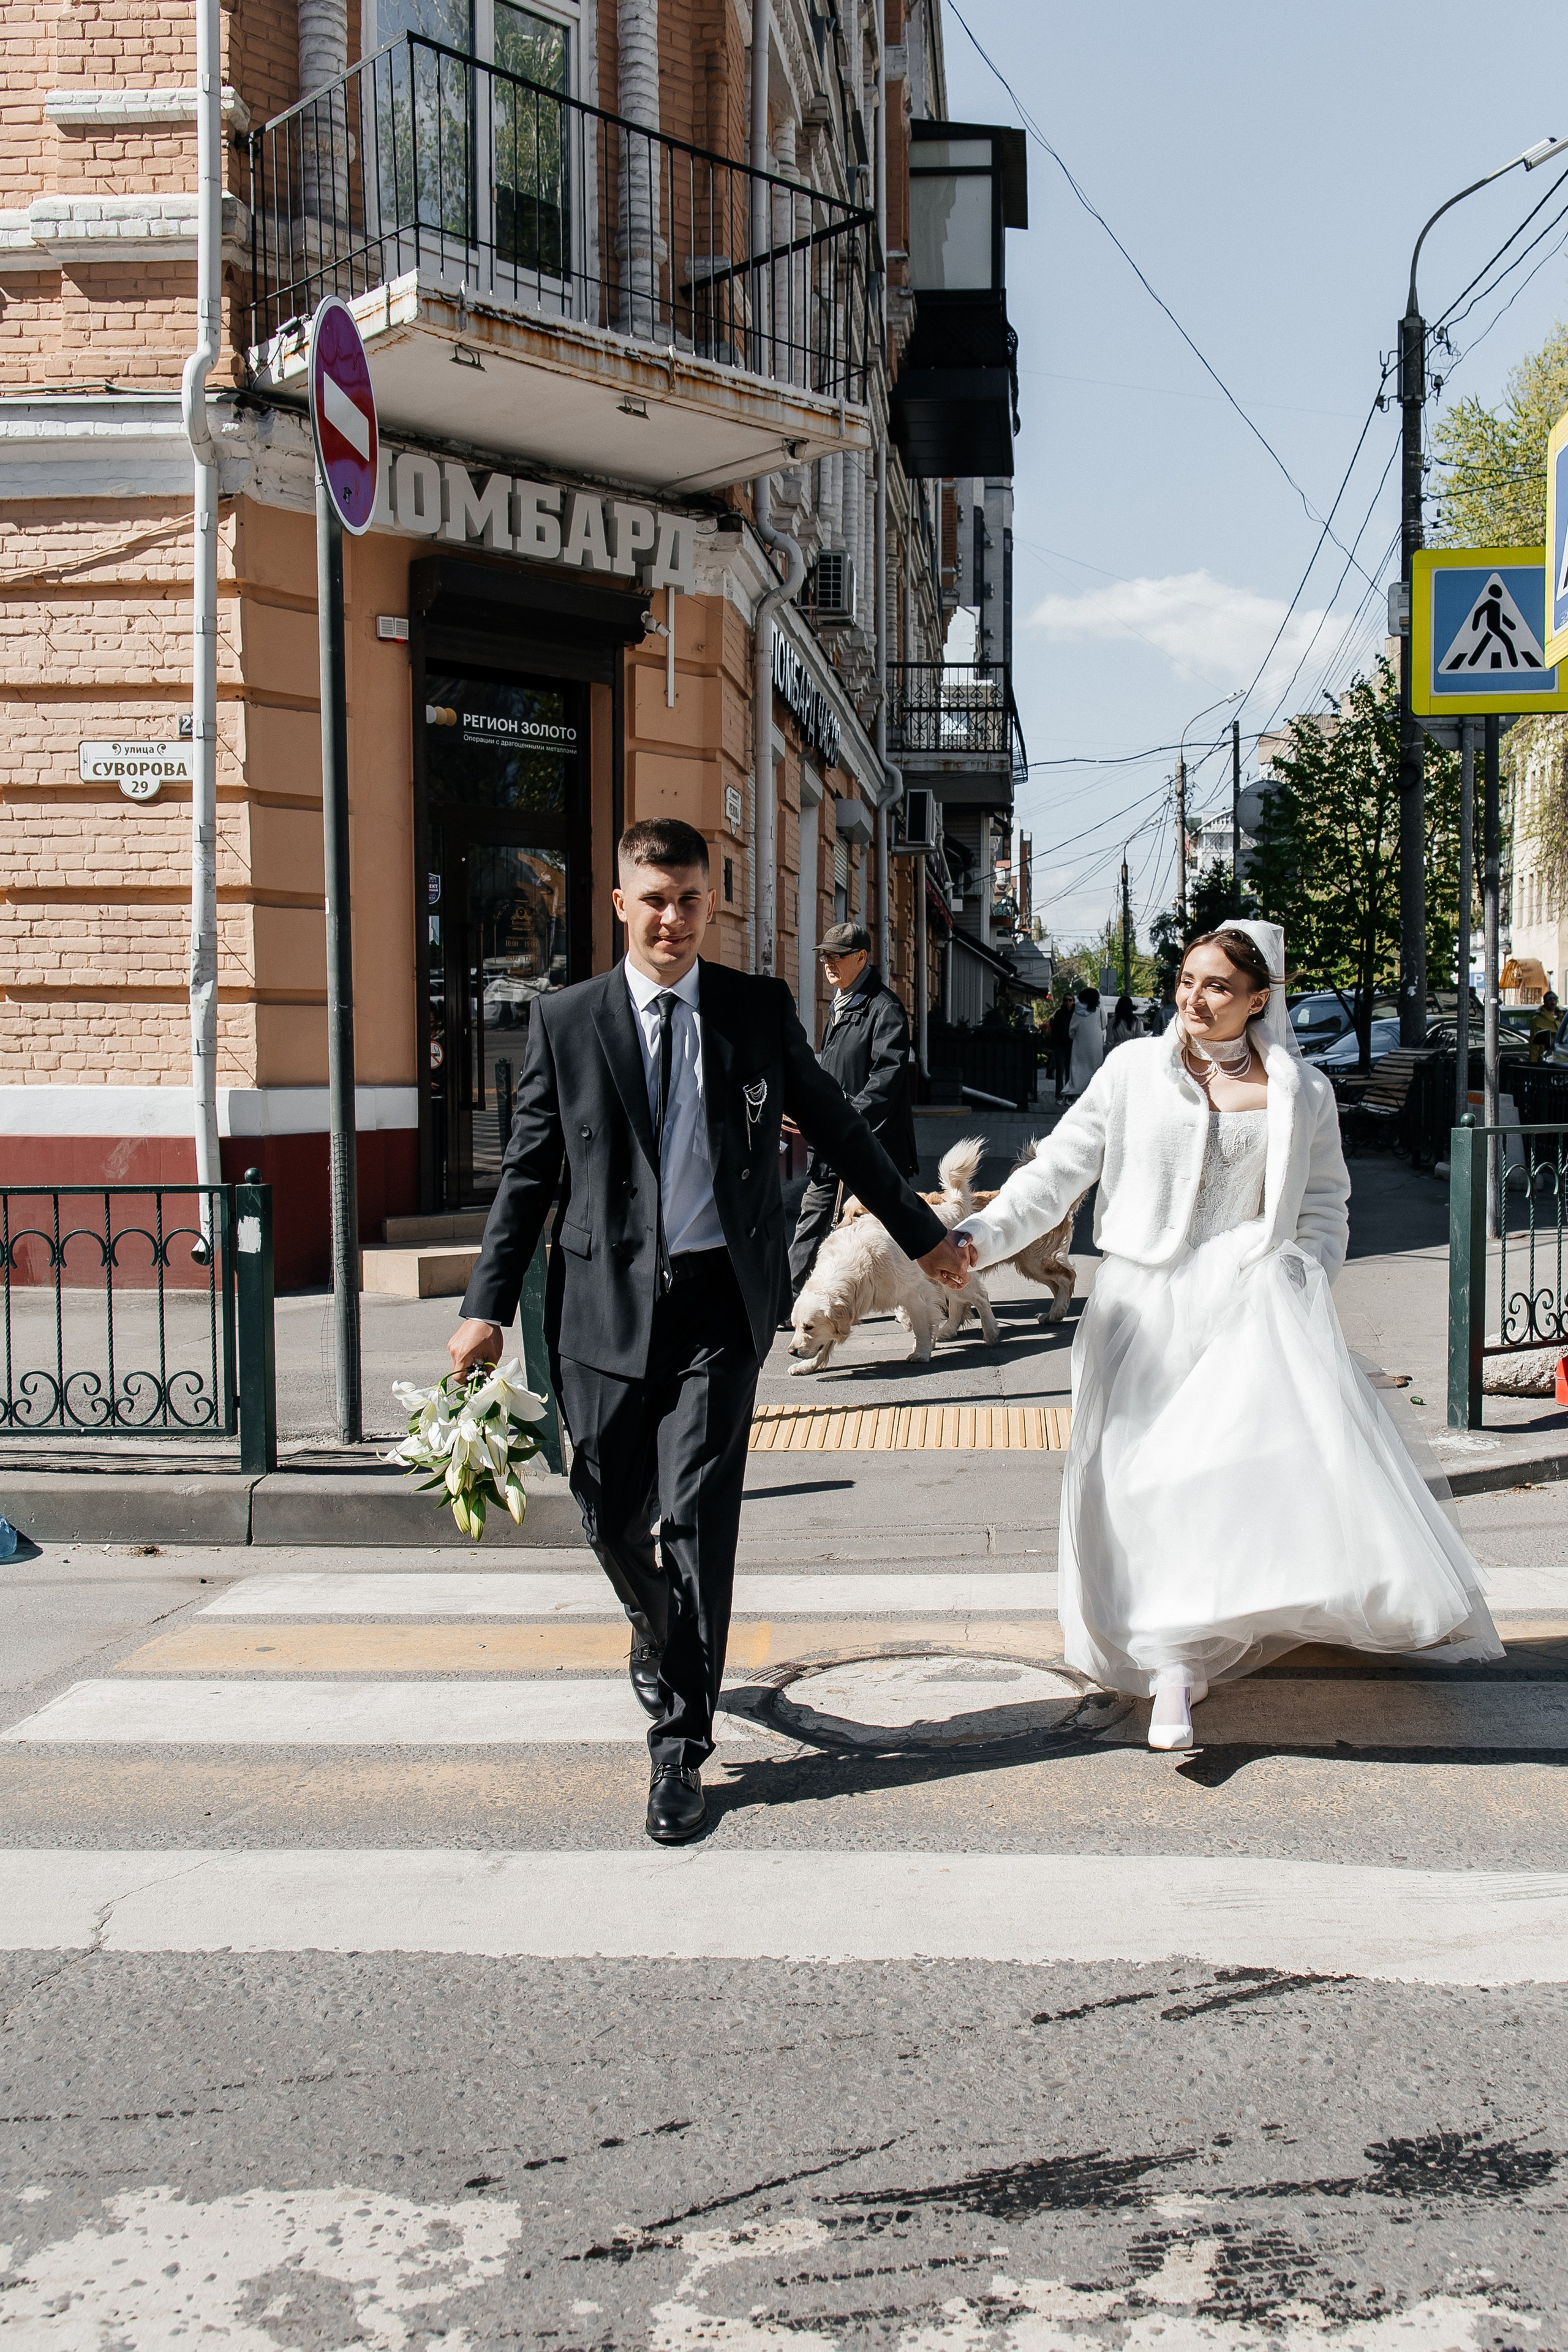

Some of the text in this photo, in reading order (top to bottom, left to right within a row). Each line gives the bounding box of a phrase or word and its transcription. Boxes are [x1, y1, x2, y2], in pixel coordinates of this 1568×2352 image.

[181, 715, 193, 733] 2
[463, 713, 576, 740] РЕГИОН ЗОЛОТО
[463, 734, 494, 745] Операции
[501, 740, 545, 751] драгоценными
[124, 746, 154, 755] улица
[92, 763, 187, 776] СУВОРОВА
[132, 781, 148, 793] 29
[1474, 974, 1485, 987] P
